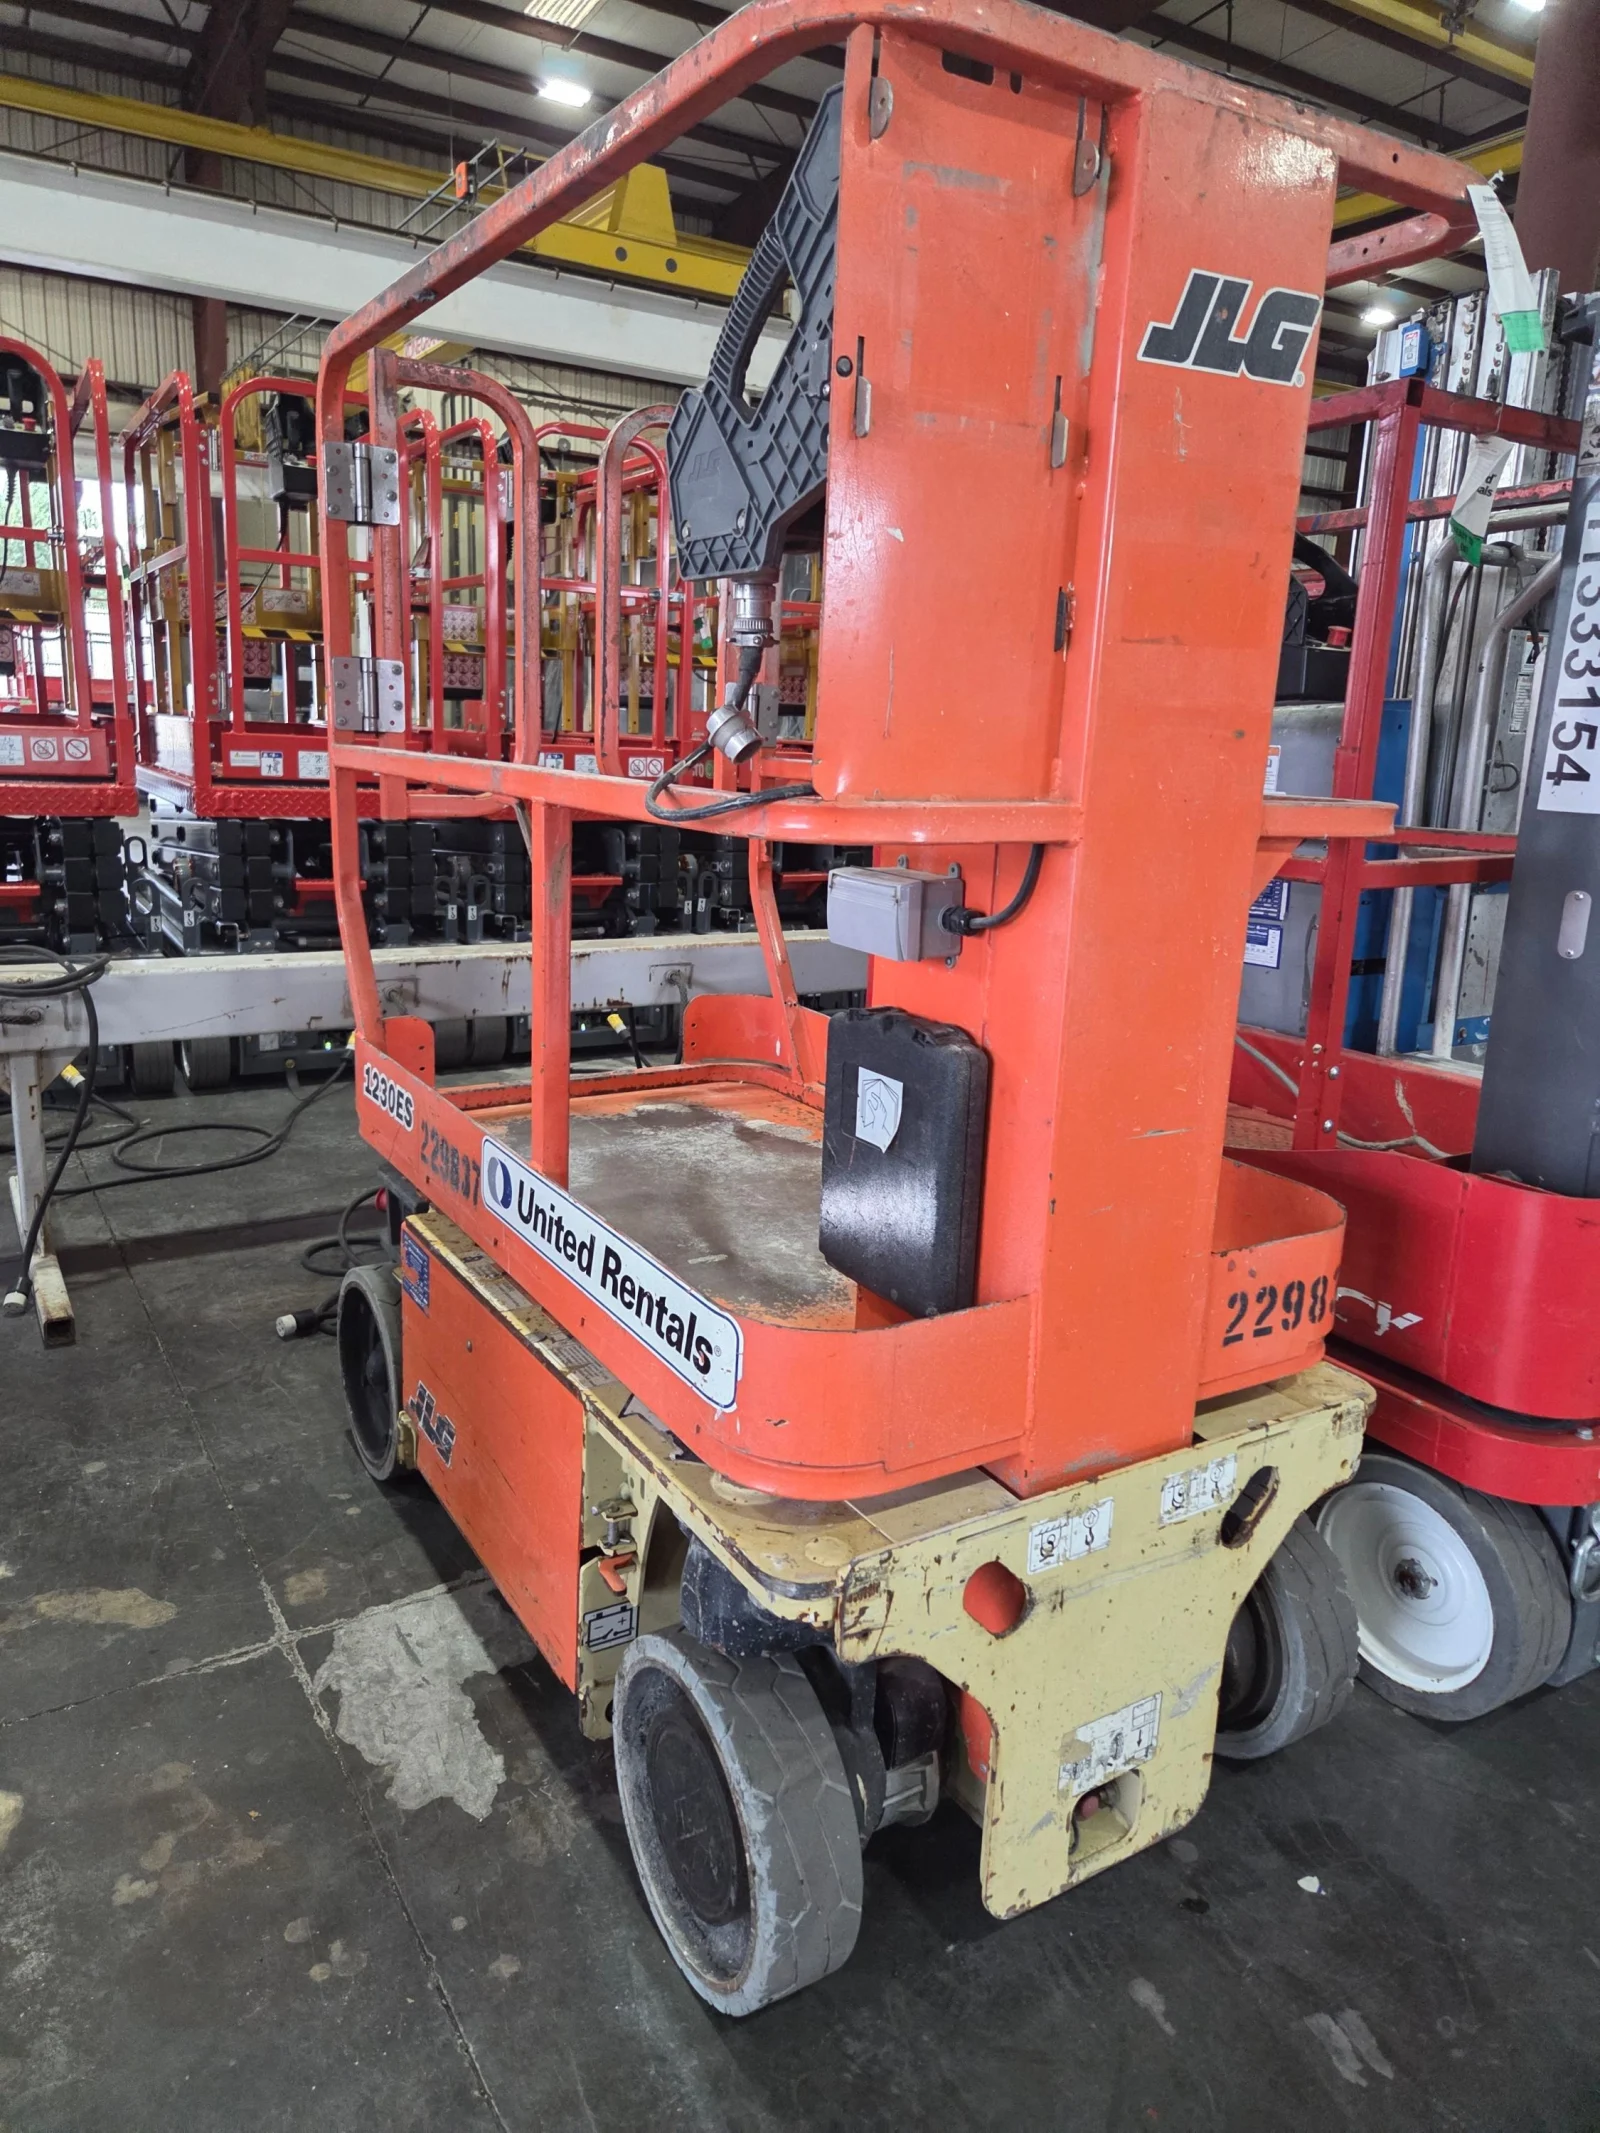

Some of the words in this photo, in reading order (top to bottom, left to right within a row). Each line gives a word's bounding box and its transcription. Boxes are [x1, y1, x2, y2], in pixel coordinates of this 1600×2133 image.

[1140, 270, 1321, 385] JLG
[1546, 520, 1600, 785] 333154
[364, 1065, 414, 1130] 1230ES
[517, 1179, 595, 1277] United
[600, 1245, 714, 1376] Rentals
[1222, 1267, 1340, 1347] 2298
[408, 1380, 456, 1468] JLG
